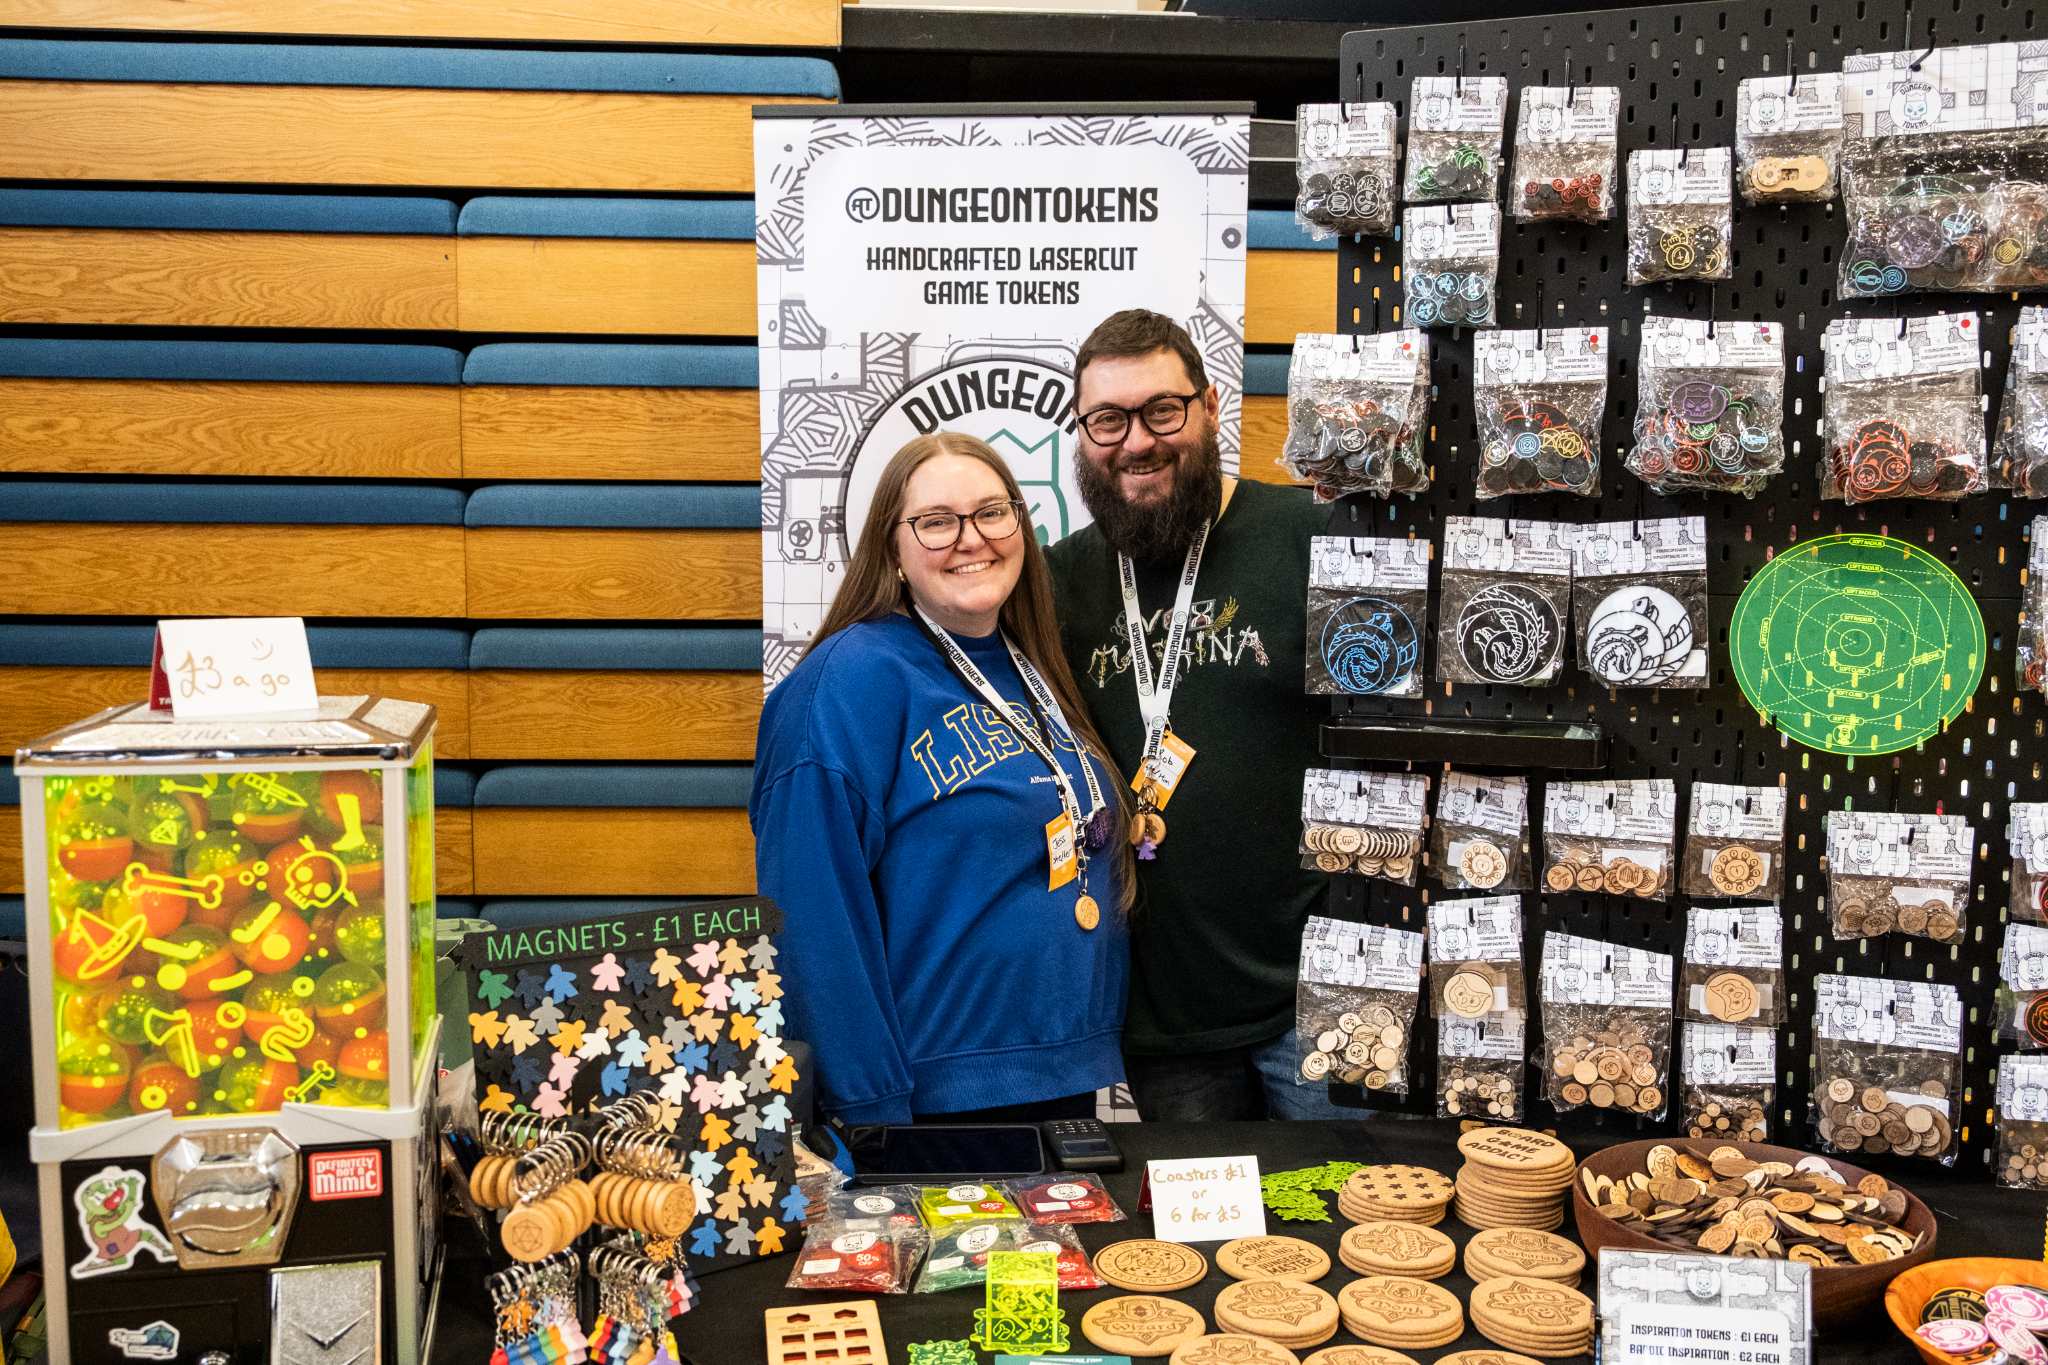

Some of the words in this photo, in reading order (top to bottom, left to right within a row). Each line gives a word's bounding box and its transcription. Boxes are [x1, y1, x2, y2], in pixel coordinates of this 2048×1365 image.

[866, 247, 1022, 271] HANDCRAFTED
[1029, 247, 1138, 271] LASERCUT
[924, 281, 989, 305] GAME
[996, 281, 1080, 305] TOKENS
[937, 633, 985, 687] DUNGEONTOKENS
[1162, 624, 1184, 690] DUNGEONTOKENS
[176, 651, 222, 698] £3
[233, 674, 250, 688] a
[261, 674, 290, 696] go
[487, 922, 627, 962] MAGNETS
[652, 916, 681, 943] £1
[694, 906, 761, 937] EACH
[316, 1156, 375, 1173] DEFINITELY
[1153, 1167, 1218, 1184] Coasters
[1225, 1163, 1248, 1182] £1
[1192, 1189, 1207, 1200] or
[1171, 1207, 1182, 1223] 6
[1192, 1205, 1210, 1223] for
[1217, 1205, 1241, 1223] £5
[856, 1253, 880, 1262] 50%
[1112, 1322, 1177, 1331] Wizard
[1631, 1324, 1692, 1338] INSPIRATION
[1695, 1328, 1731, 1341] TOKENS
[1754, 1333, 1779, 1344] EACH
[1668, 1346, 1729, 1360] INSPIRATION
[1755, 1352, 1780, 1364] EACH
